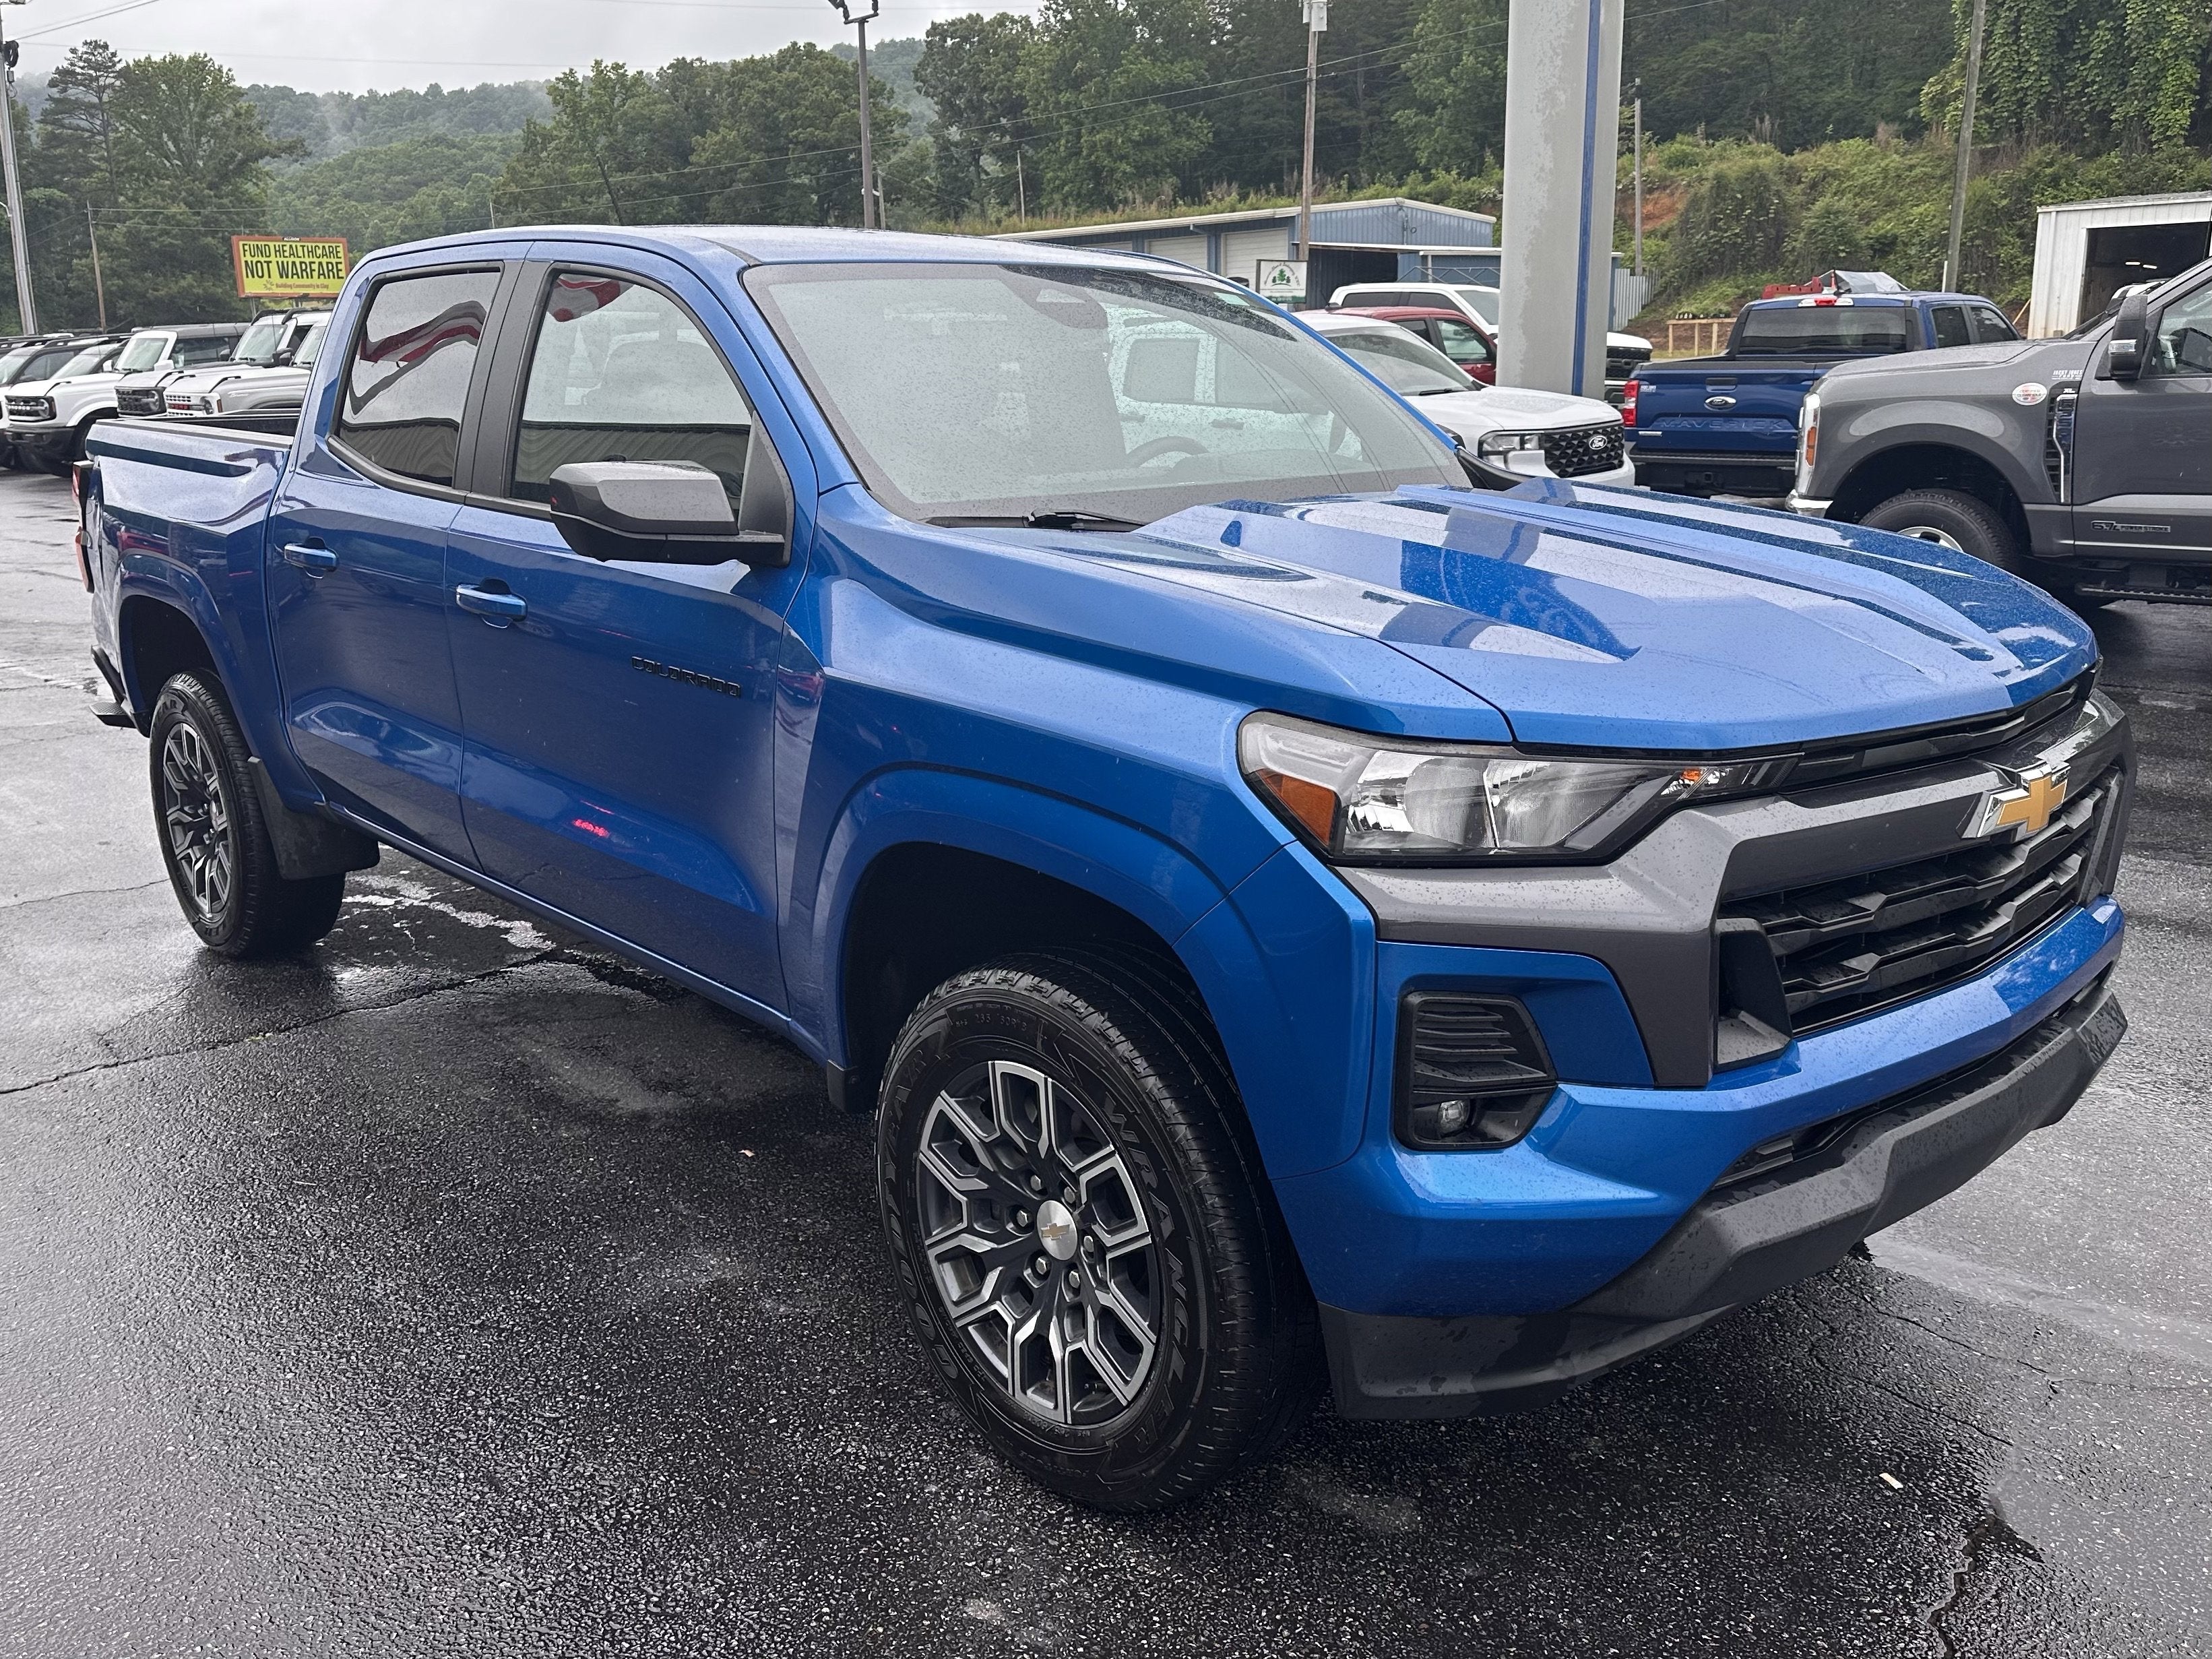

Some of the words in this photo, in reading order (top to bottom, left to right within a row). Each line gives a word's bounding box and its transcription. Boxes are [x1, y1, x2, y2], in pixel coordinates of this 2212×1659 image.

[242, 243, 271, 258] FUND
[274, 244, 342, 259] HEALTHCARE
[244, 260, 272, 278] NOT
[276, 260, 344, 280] WARFARE
[1660, 419, 1783, 429] MAVERICK
[631, 656, 741, 697] COLORADO
[884, 1048, 959, 1379] GOODYEAR
[1103, 1091, 1190, 1456] WRANGLER
